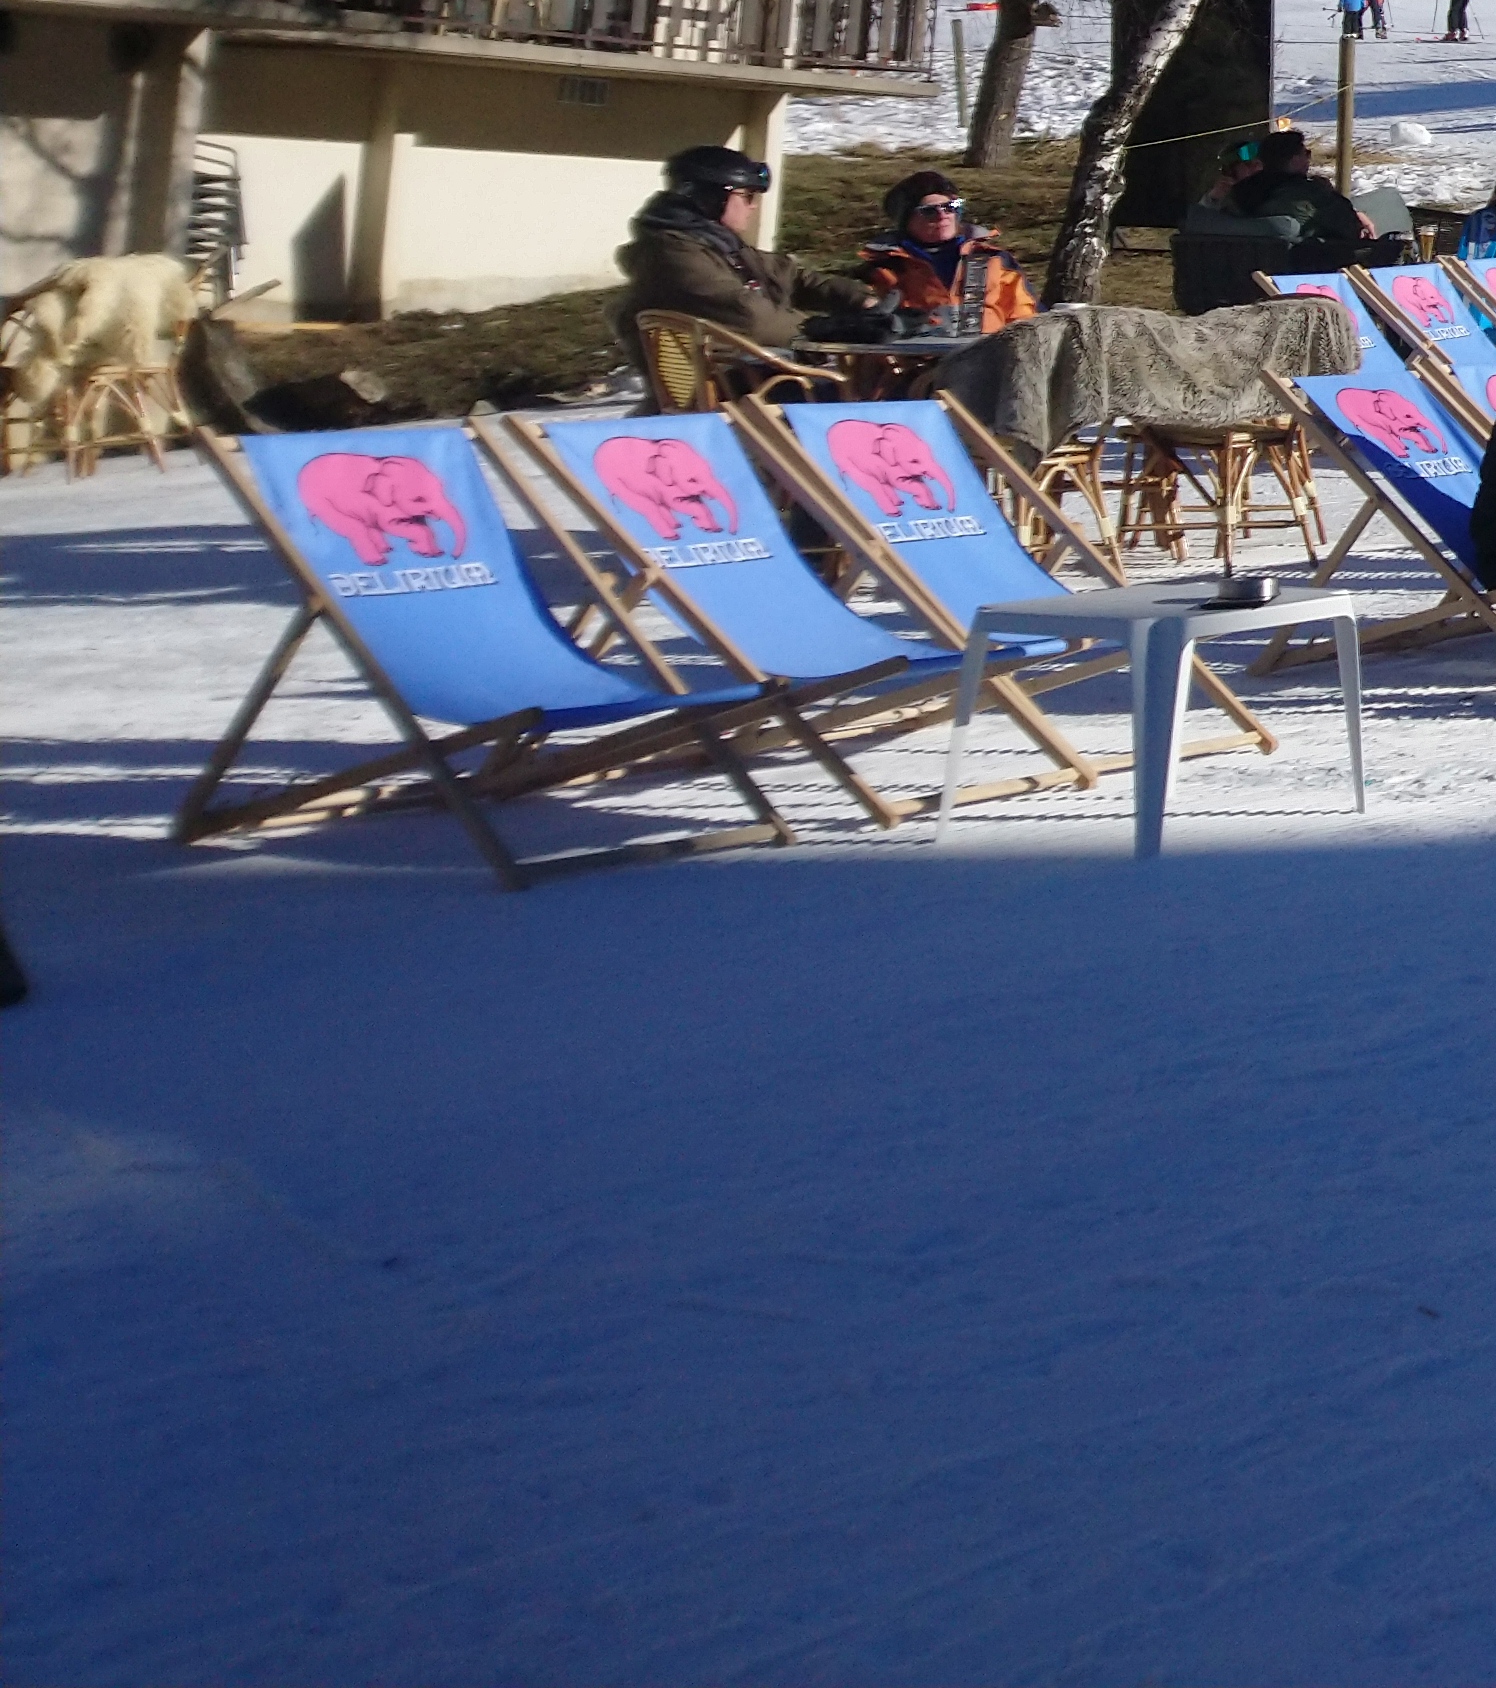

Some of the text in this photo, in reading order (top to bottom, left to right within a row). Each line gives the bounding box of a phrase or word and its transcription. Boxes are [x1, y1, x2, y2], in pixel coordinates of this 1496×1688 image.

[1423, 325, 1471, 341] LIRIUM
[874, 515, 988, 543] ELIRIUM
[329, 562, 498, 599] DELIRIUM
